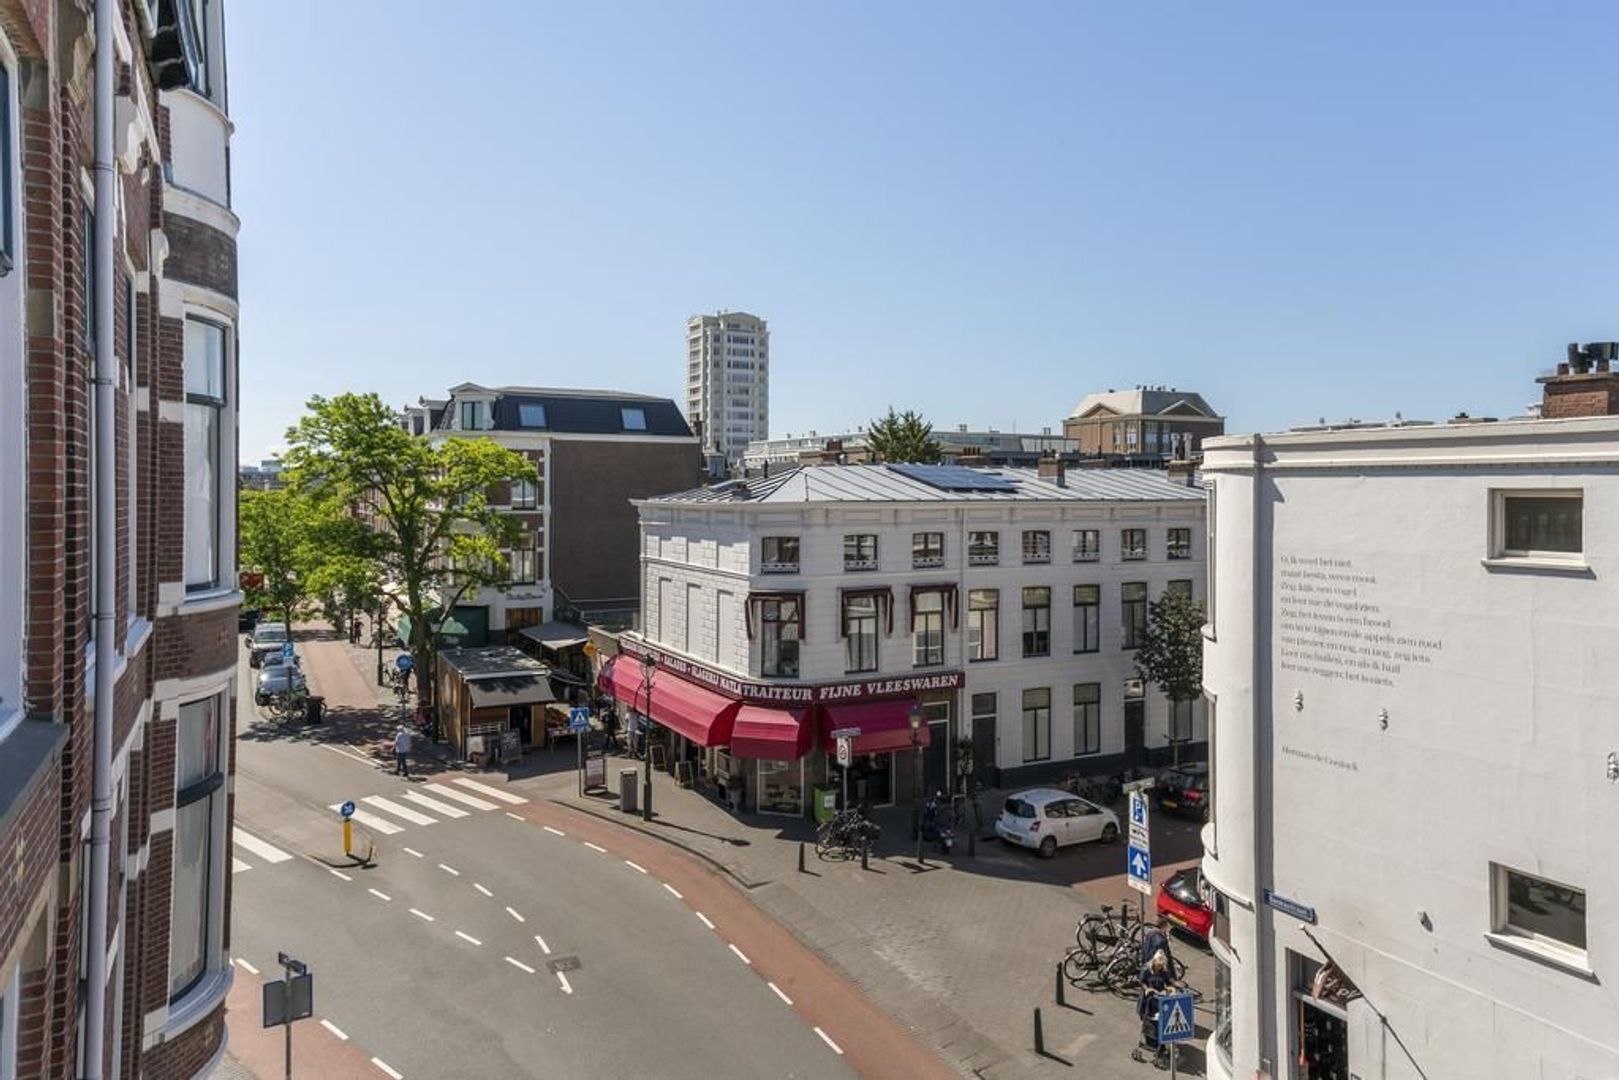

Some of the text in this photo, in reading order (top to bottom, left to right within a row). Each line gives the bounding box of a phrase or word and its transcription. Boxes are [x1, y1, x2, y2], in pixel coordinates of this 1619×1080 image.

[742, 684, 813, 700] TRAITEUR
[820, 675, 959, 700] FIJNE VLEESWAREN
